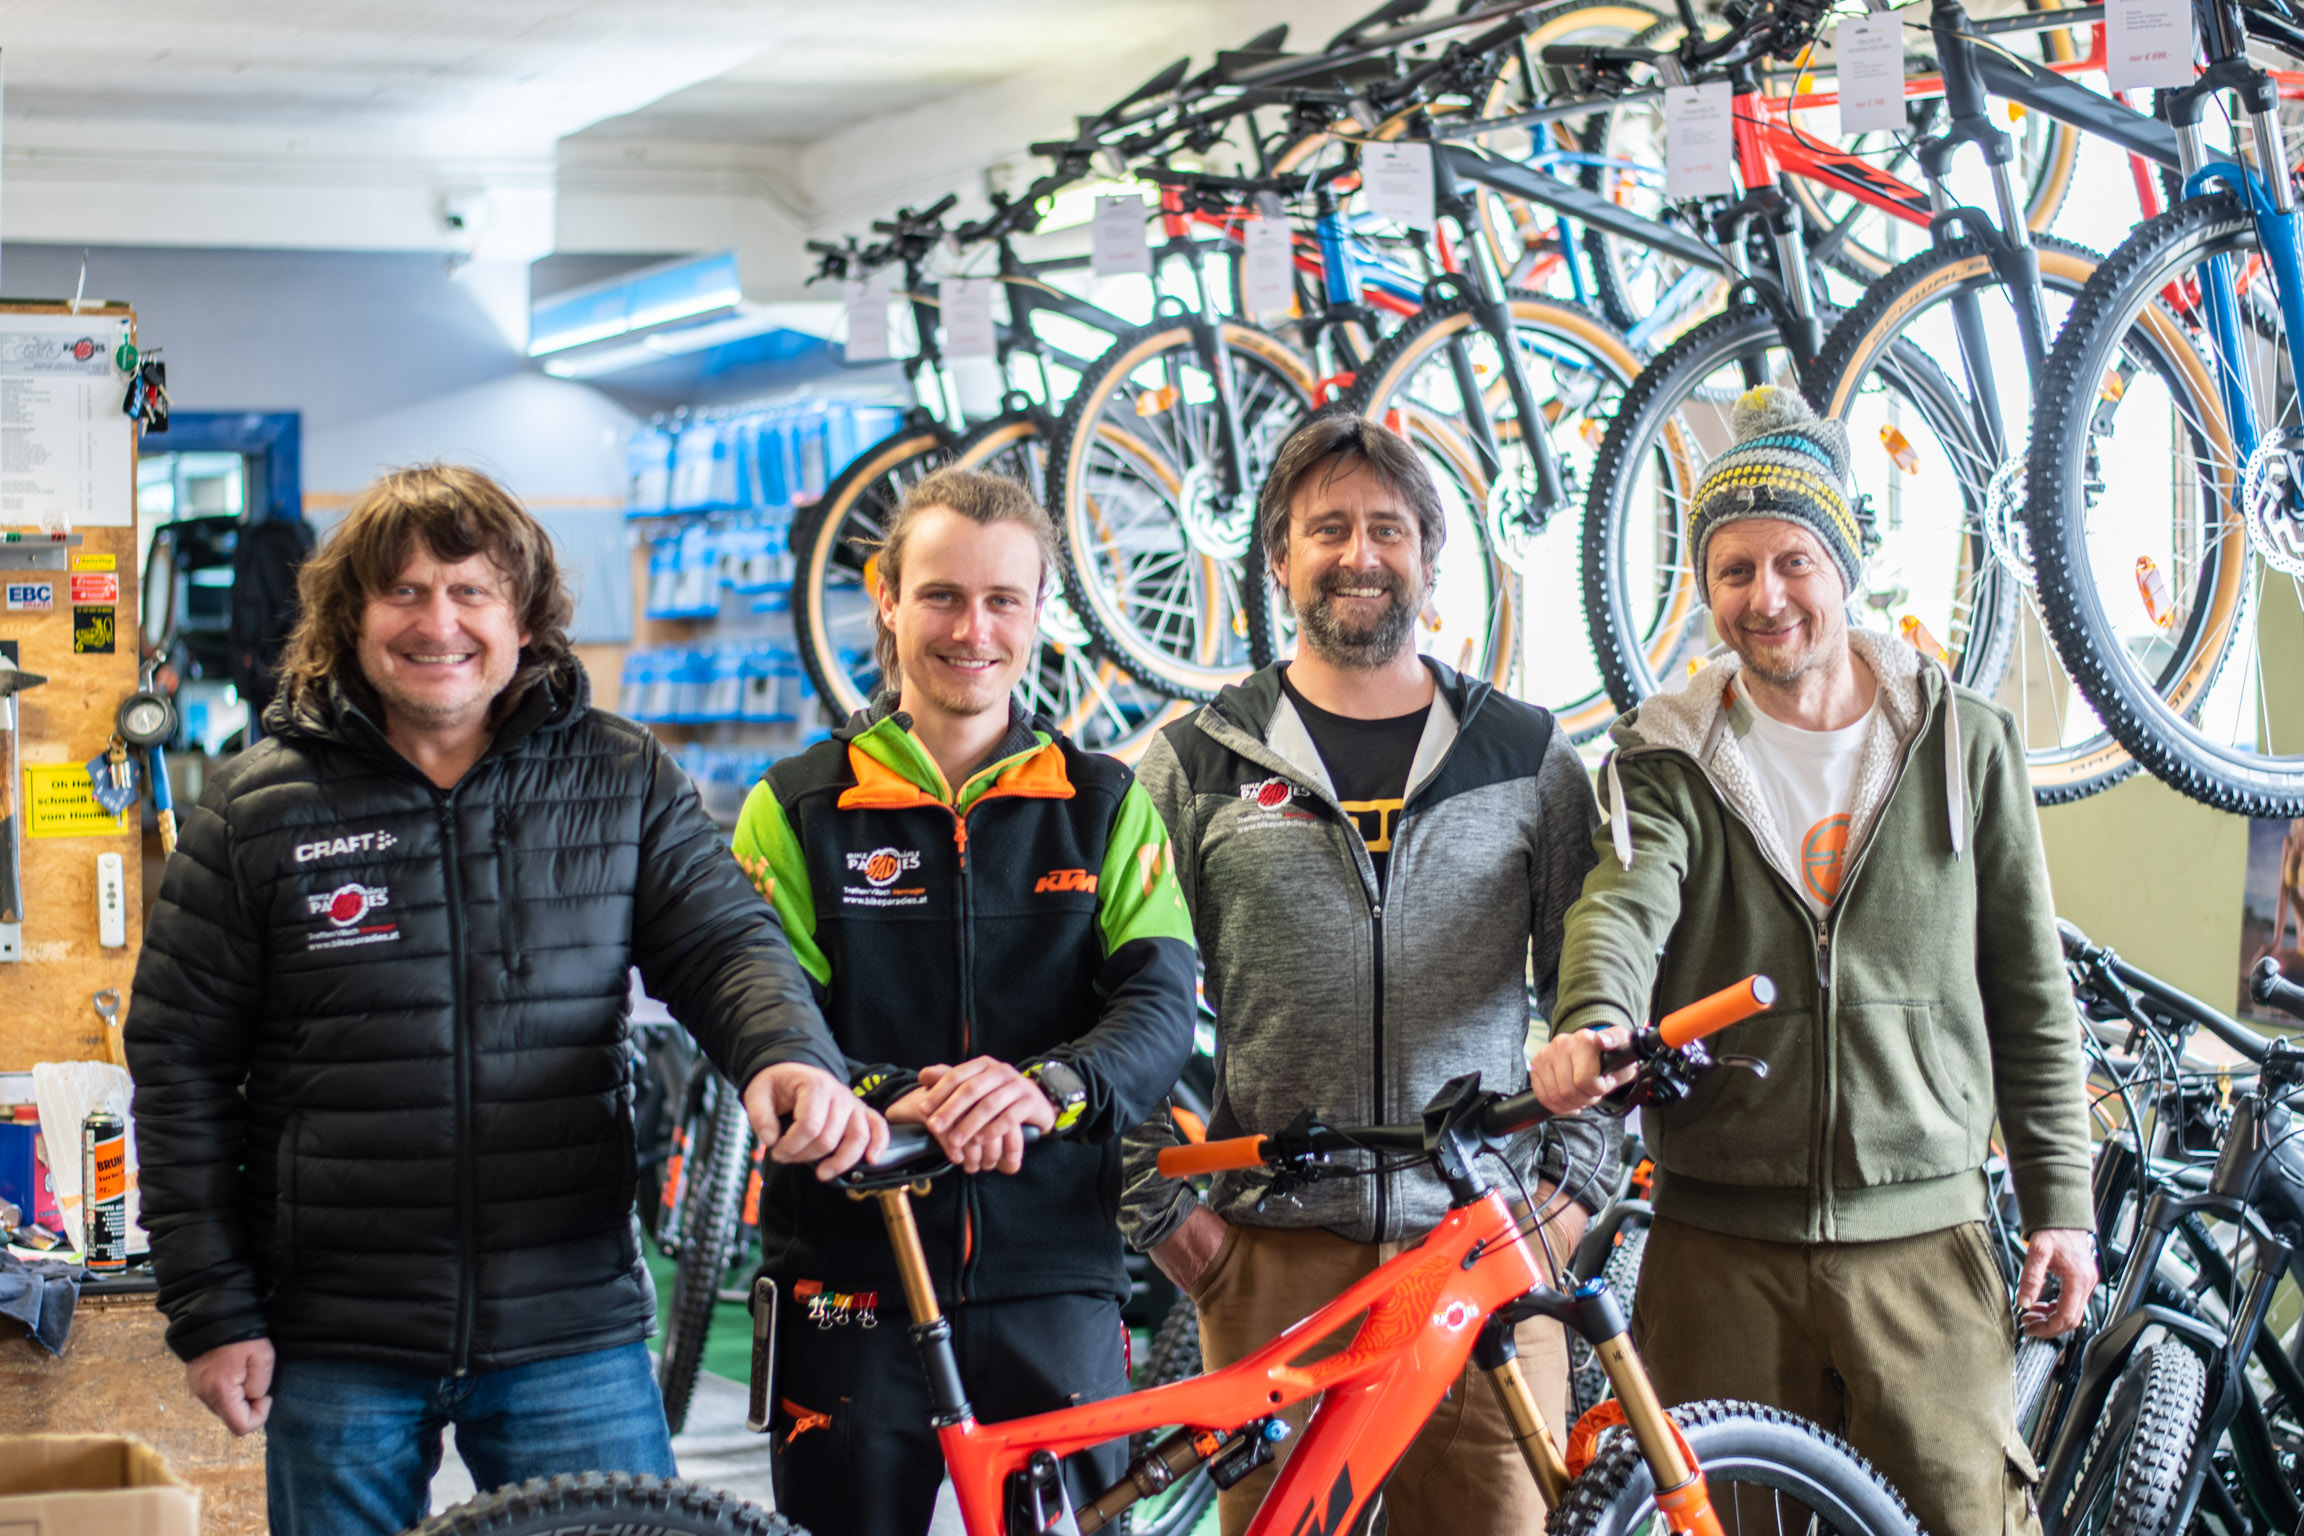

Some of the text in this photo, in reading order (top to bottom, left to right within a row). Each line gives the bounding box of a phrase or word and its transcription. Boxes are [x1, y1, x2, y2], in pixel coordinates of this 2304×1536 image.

[9, 586, 51, 601] EBC
[52, 779, 95, 789] Oh Her
[295, 832, 375, 862] CRAFT
[1034, 868, 1099, 894] KTM
[843, 895, 928, 907] www.bikeparadies.at
[96, 1152, 125, 1172] BRUN
[2062, 1409, 2111, 1518] MAXXIS
